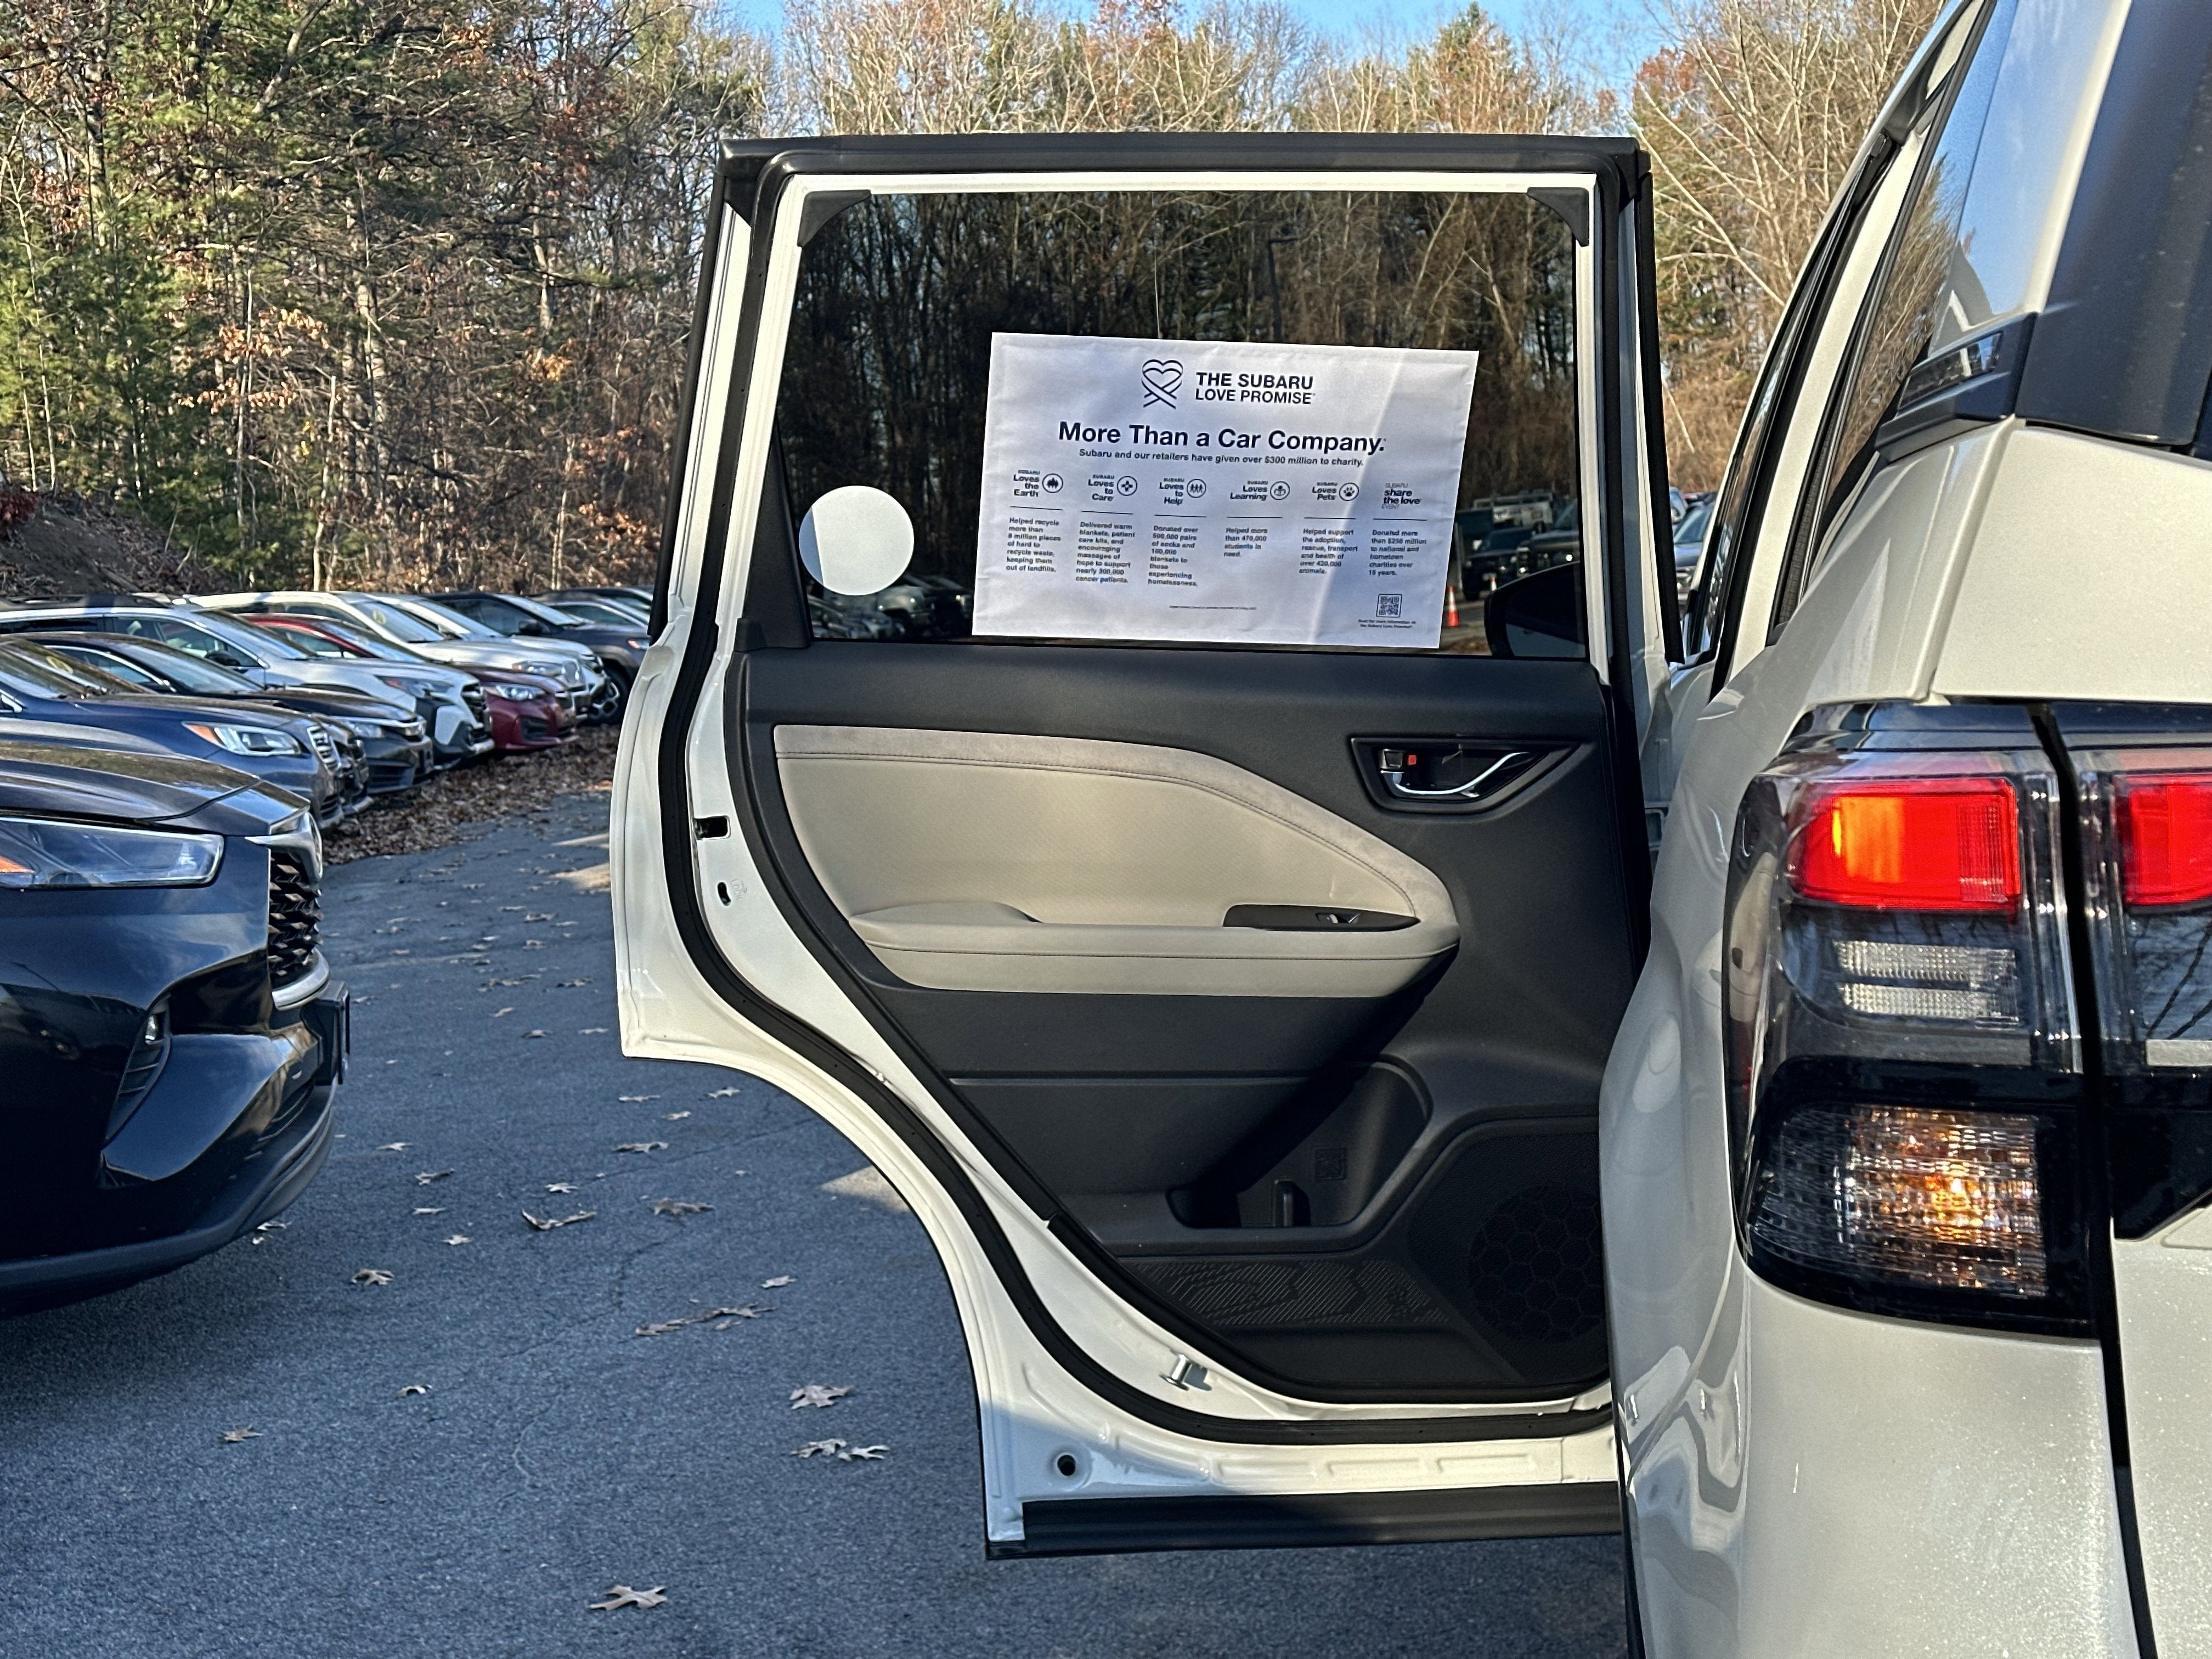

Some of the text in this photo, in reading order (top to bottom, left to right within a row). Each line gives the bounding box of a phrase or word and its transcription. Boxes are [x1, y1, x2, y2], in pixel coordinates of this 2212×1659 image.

[1195, 372, 1313, 390] THE SUBARU
[1195, 388, 1312, 404] LOVE PROMISE
[1058, 421, 1121, 443] More
[1129, 425, 1188, 447] Than
[1196, 431, 1210, 447] a
[1218, 428, 1261, 449] Car
[1079, 449, 1112, 459] Subaru
[1115, 450, 1132, 459] and
[1152, 451, 1189, 461] retailers
[1192, 453, 1212, 462] have
[1215, 454, 1240, 465] given
[1265, 455, 1285, 465] $300
[1288, 455, 1317, 465] million
[1321, 457, 1329, 465] to
[1331, 457, 1363, 467] charity.
[1013, 474, 1040, 482] Loves
[1088, 478, 1114, 487] Loves
[1014, 489, 1039, 497] Earth
[1092, 493, 1113, 501] Care
[1230, 492, 1267, 501] Learning
[1401, 496, 1421, 505] love
[1009, 517, 1033, 526] Helped
[1007, 556, 1033, 564] keeping
